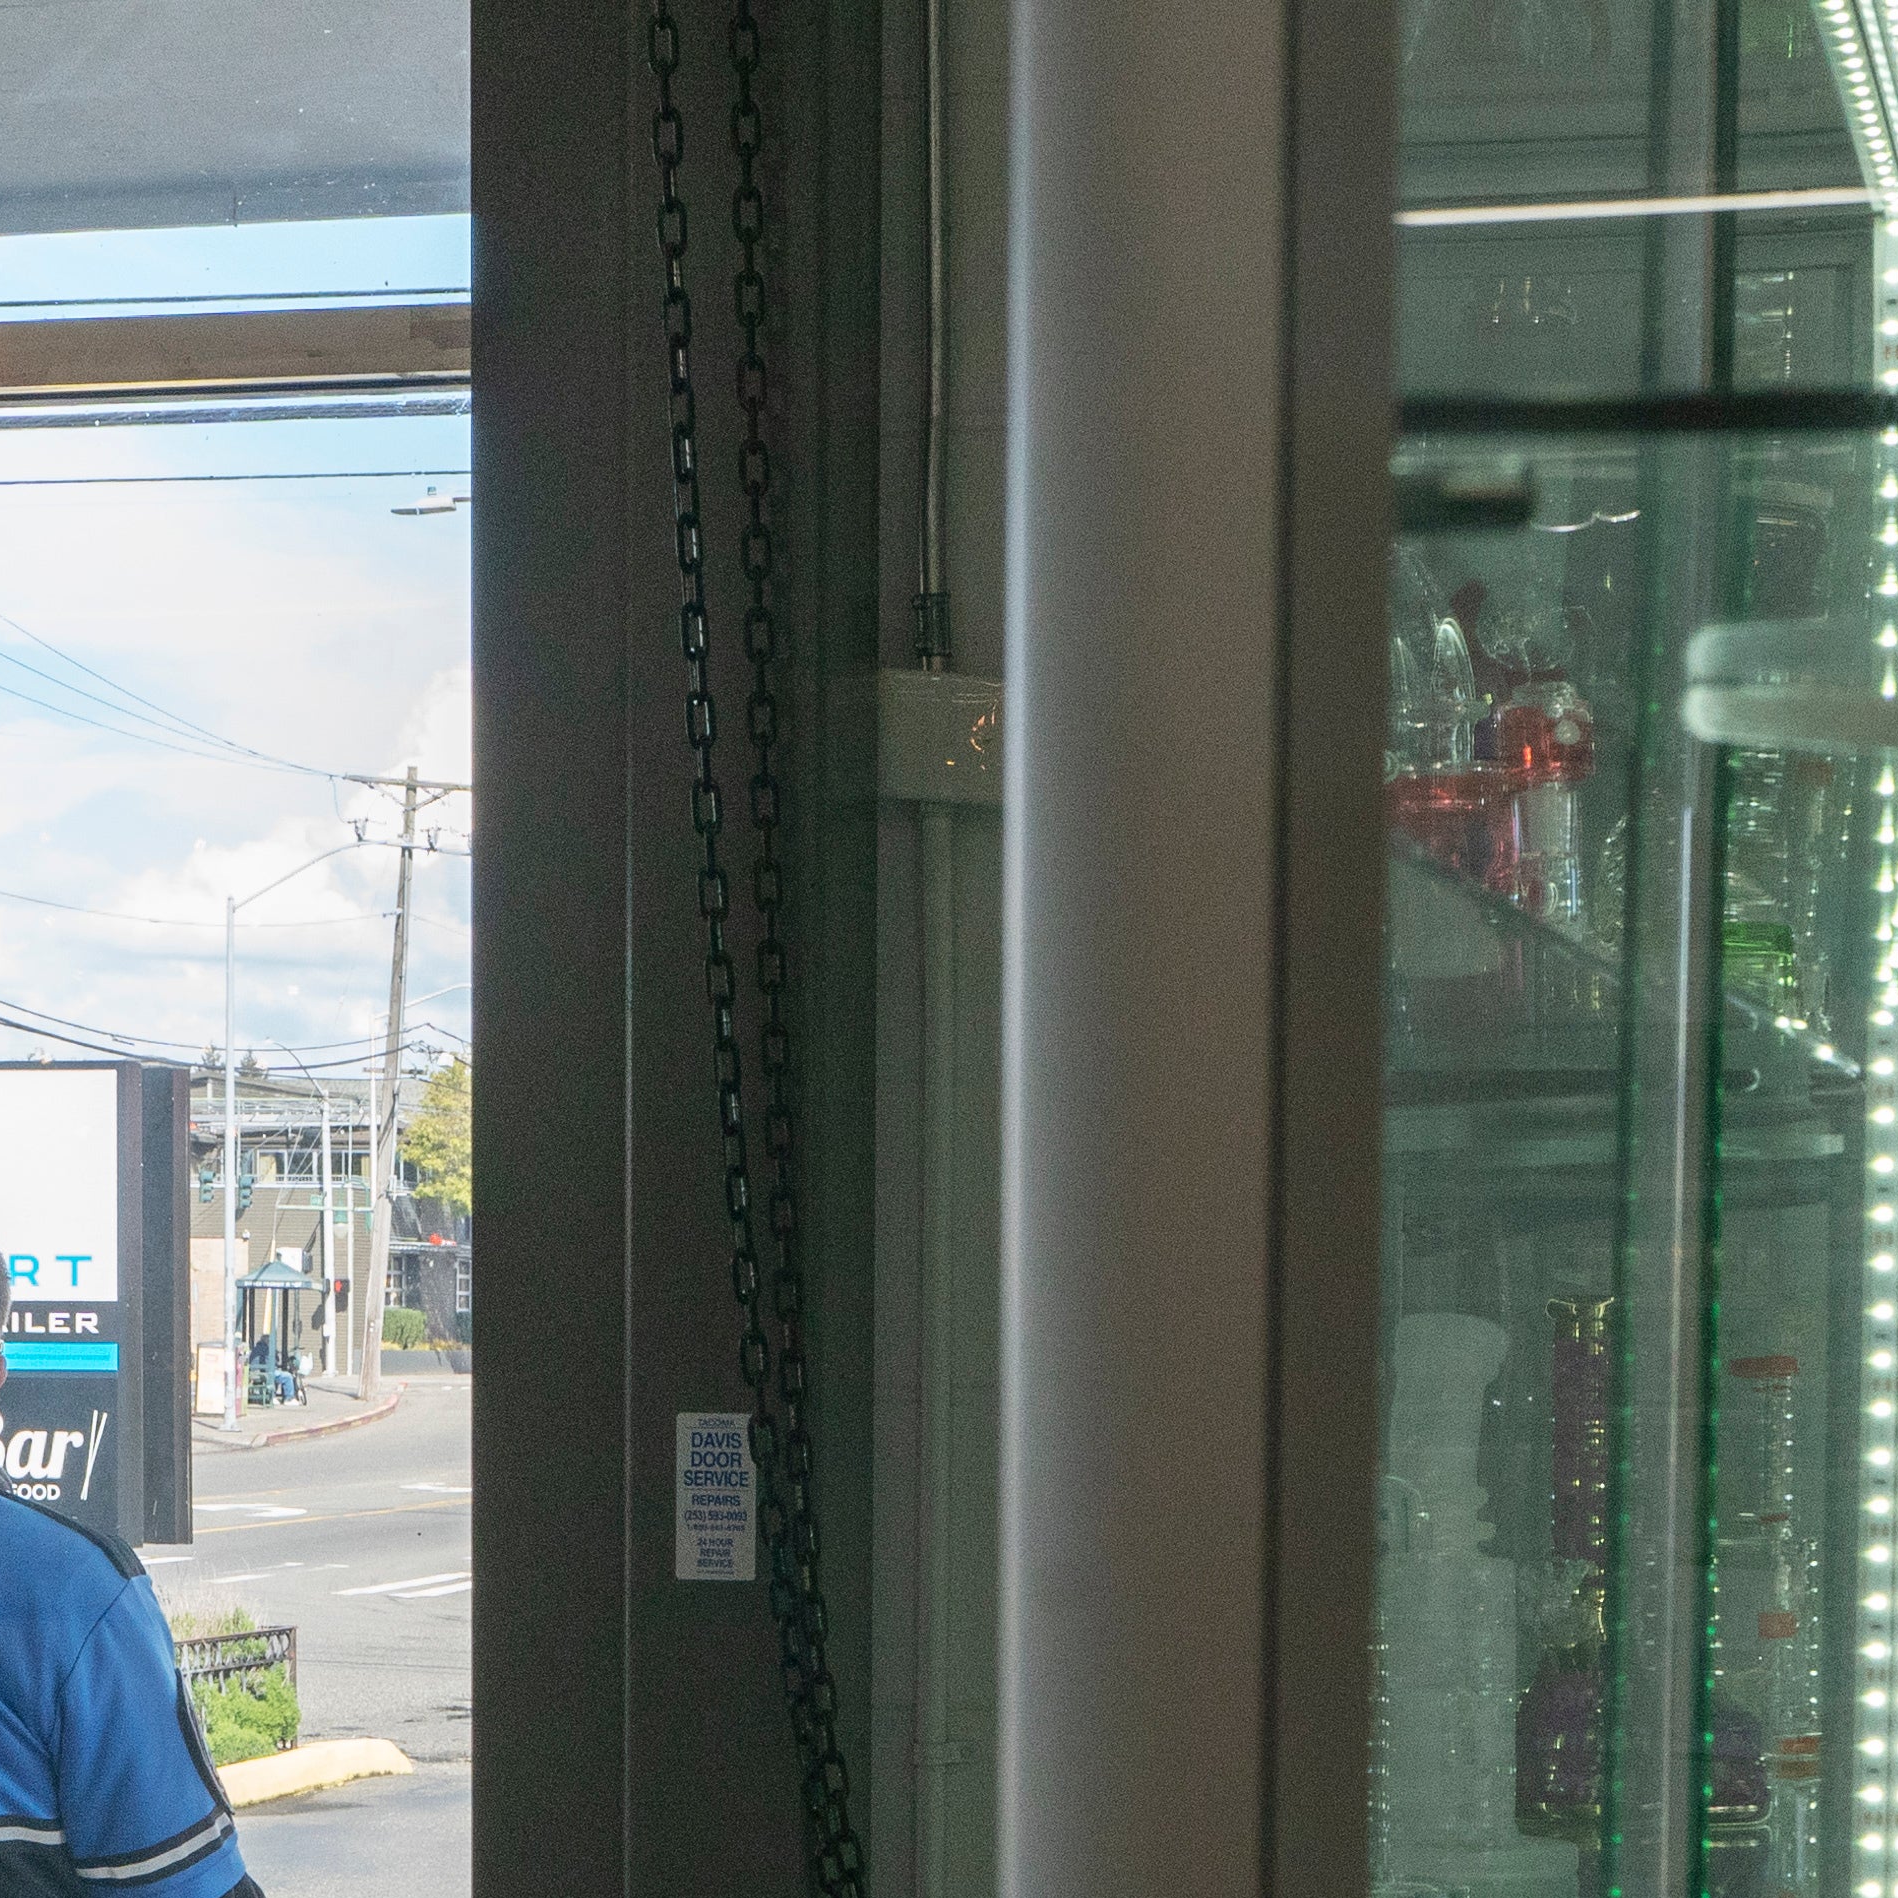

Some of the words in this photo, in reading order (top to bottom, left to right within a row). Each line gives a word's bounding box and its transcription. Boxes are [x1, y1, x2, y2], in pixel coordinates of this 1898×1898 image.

[691, 1432, 742, 1449] DAVIS
[691, 1451, 742, 1468] DOOR
[683, 1470, 749, 1487] SERVICE
[692, 1495, 741, 1506] REPAIRS
[684, 1510, 706, 1522] (253)
[709, 1538, 734, 1547] HOUR
[696, 1558, 734, 1568] SERVICE
